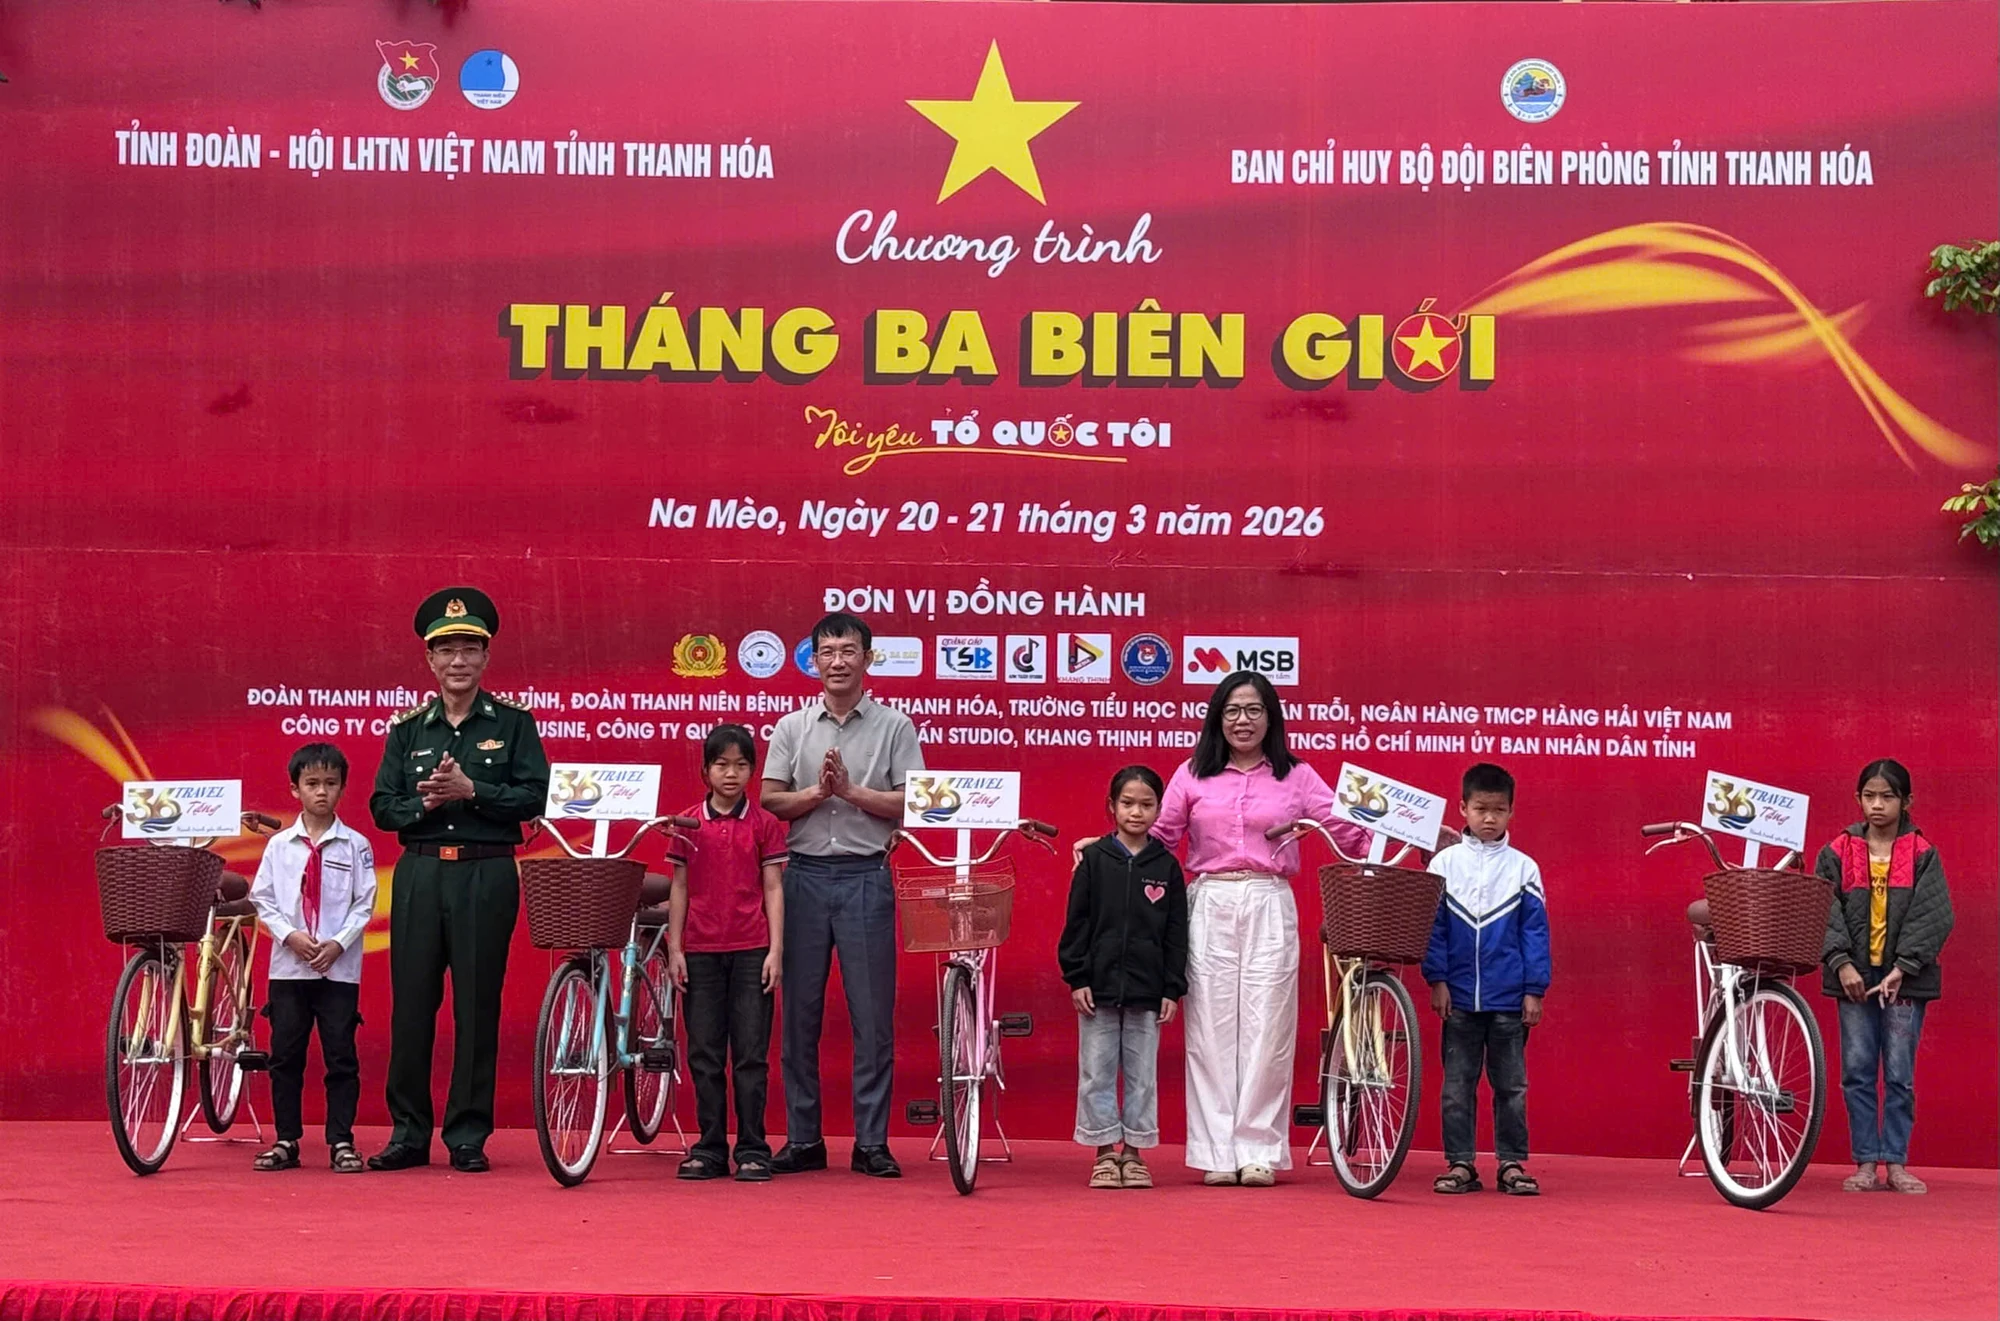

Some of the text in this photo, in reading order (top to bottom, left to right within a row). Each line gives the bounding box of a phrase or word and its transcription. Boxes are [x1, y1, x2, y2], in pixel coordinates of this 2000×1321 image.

[116, 119, 177, 166] TỈNH
[186, 126, 260, 167] ĐOÀN
[289, 128, 333, 178] HỘI
[343, 136, 409, 171] LHTN
[418, 131, 474, 180] VIỆT
[483, 139, 545, 174] NAM
[554, 129, 614, 176] TỈNH
[624, 142, 711, 178] THANH
[720, 137, 773, 179] HÓA
[1231, 138, 1874, 192] BAN CHỈ HUY BỘ ĐỘI BIÊN PHÒNG TỈNH THANH HÓA
[836, 209, 1163, 278] Chương trình
[506, 291, 1496, 388] THÁNG BA BIÊN GIỚI
[930, 408, 981, 445] TỔ
[991, 413, 1099, 447] QUỐC
[1107, 416, 1172, 448] TÔI
[648, 498, 697, 528] Na
[706, 496, 786, 535] Mèo,
[798, 498, 889, 539] Ngày
[896, 501, 940, 532] 20
[966, 502, 1005, 532] 21
[1018, 500, 1117, 543] tháng
[1125, 504, 1147, 535] 3
[1155, 503, 1232, 536] năm
[1241, 505, 1324, 537] 2026
[823, 577, 1146, 621] ĐƠN VỊ ĐỒNG HÀNH
[941, 646, 993, 671] TSB
[1236, 649, 1295, 672] MSB
[247, 684, 303, 707] ĐOÀN
[308, 689, 371, 707] THANH
[376, 686, 417, 707] NIÊN
[518, 686, 565, 712] TỈNH,
[571, 688, 627, 710] ĐOÀN
[631, 693, 693, 711] THANH
[699, 690, 740, 712] NIÊN
[746, 689, 793, 717] BỆNH
[799, 690, 825, 708] VI
[889, 697, 951, 716] THANH
[957, 693, 1004, 720] HÓA,
[1008, 694, 1086, 718] TRƯỜNG
[1091, 691, 1128, 719] TIỂU
[1133, 701, 1177, 724] HỌC
[1281, 699, 1303, 721] ĂN
[1307, 696, 1356, 725] TRỖI,
[1361, 701, 1417, 724] NGÂN
[1423, 699, 1480, 725] HÀNG
[1484, 706, 1538, 726] TMCP
[1542, 703, 1599, 728] HÀNG
[1604, 703, 1638, 728] HẢI
[1644, 705, 1683, 733] VIỆT
[1687, 711, 1733, 730] NAM
[281, 713, 340, 736] CÔNG
[345, 718, 365, 736] TY
[596, 717, 655, 740] CÔNG
[659, 722, 680, 740] TY
[948, 726, 1019, 749] STUDIO,
[1025, 728, 1092, 747] KHANG
[1097, 730, 1153, 752] THỊNH
[1288, 731, 1336, 751] TNCS
[1342, 724, 1371, 752] HỒ
[1375, 729, 1411, 752] CHÍ
[1415, 734, 1466, 754] MINH
[1471, 729, 1495, 755] ỦY
[1501, 736, 1541, 756] BAN
[1545, 733, 1601, 757] NHÂN
[1606, 734, 1648, 758] DÂN
[1653, 734, 1697, 759] TỈNH
[125, 786, 225, 826] 36 TRAVEL
[550, 770, 646, 807] 36 TRAVEL
[907, 776, 1004, 816] 36 TRAVEL
[1338, 769, 1432, 814] 36 TRAVEL
[1707, 777, 1796, 820] 36 TRAVEL
